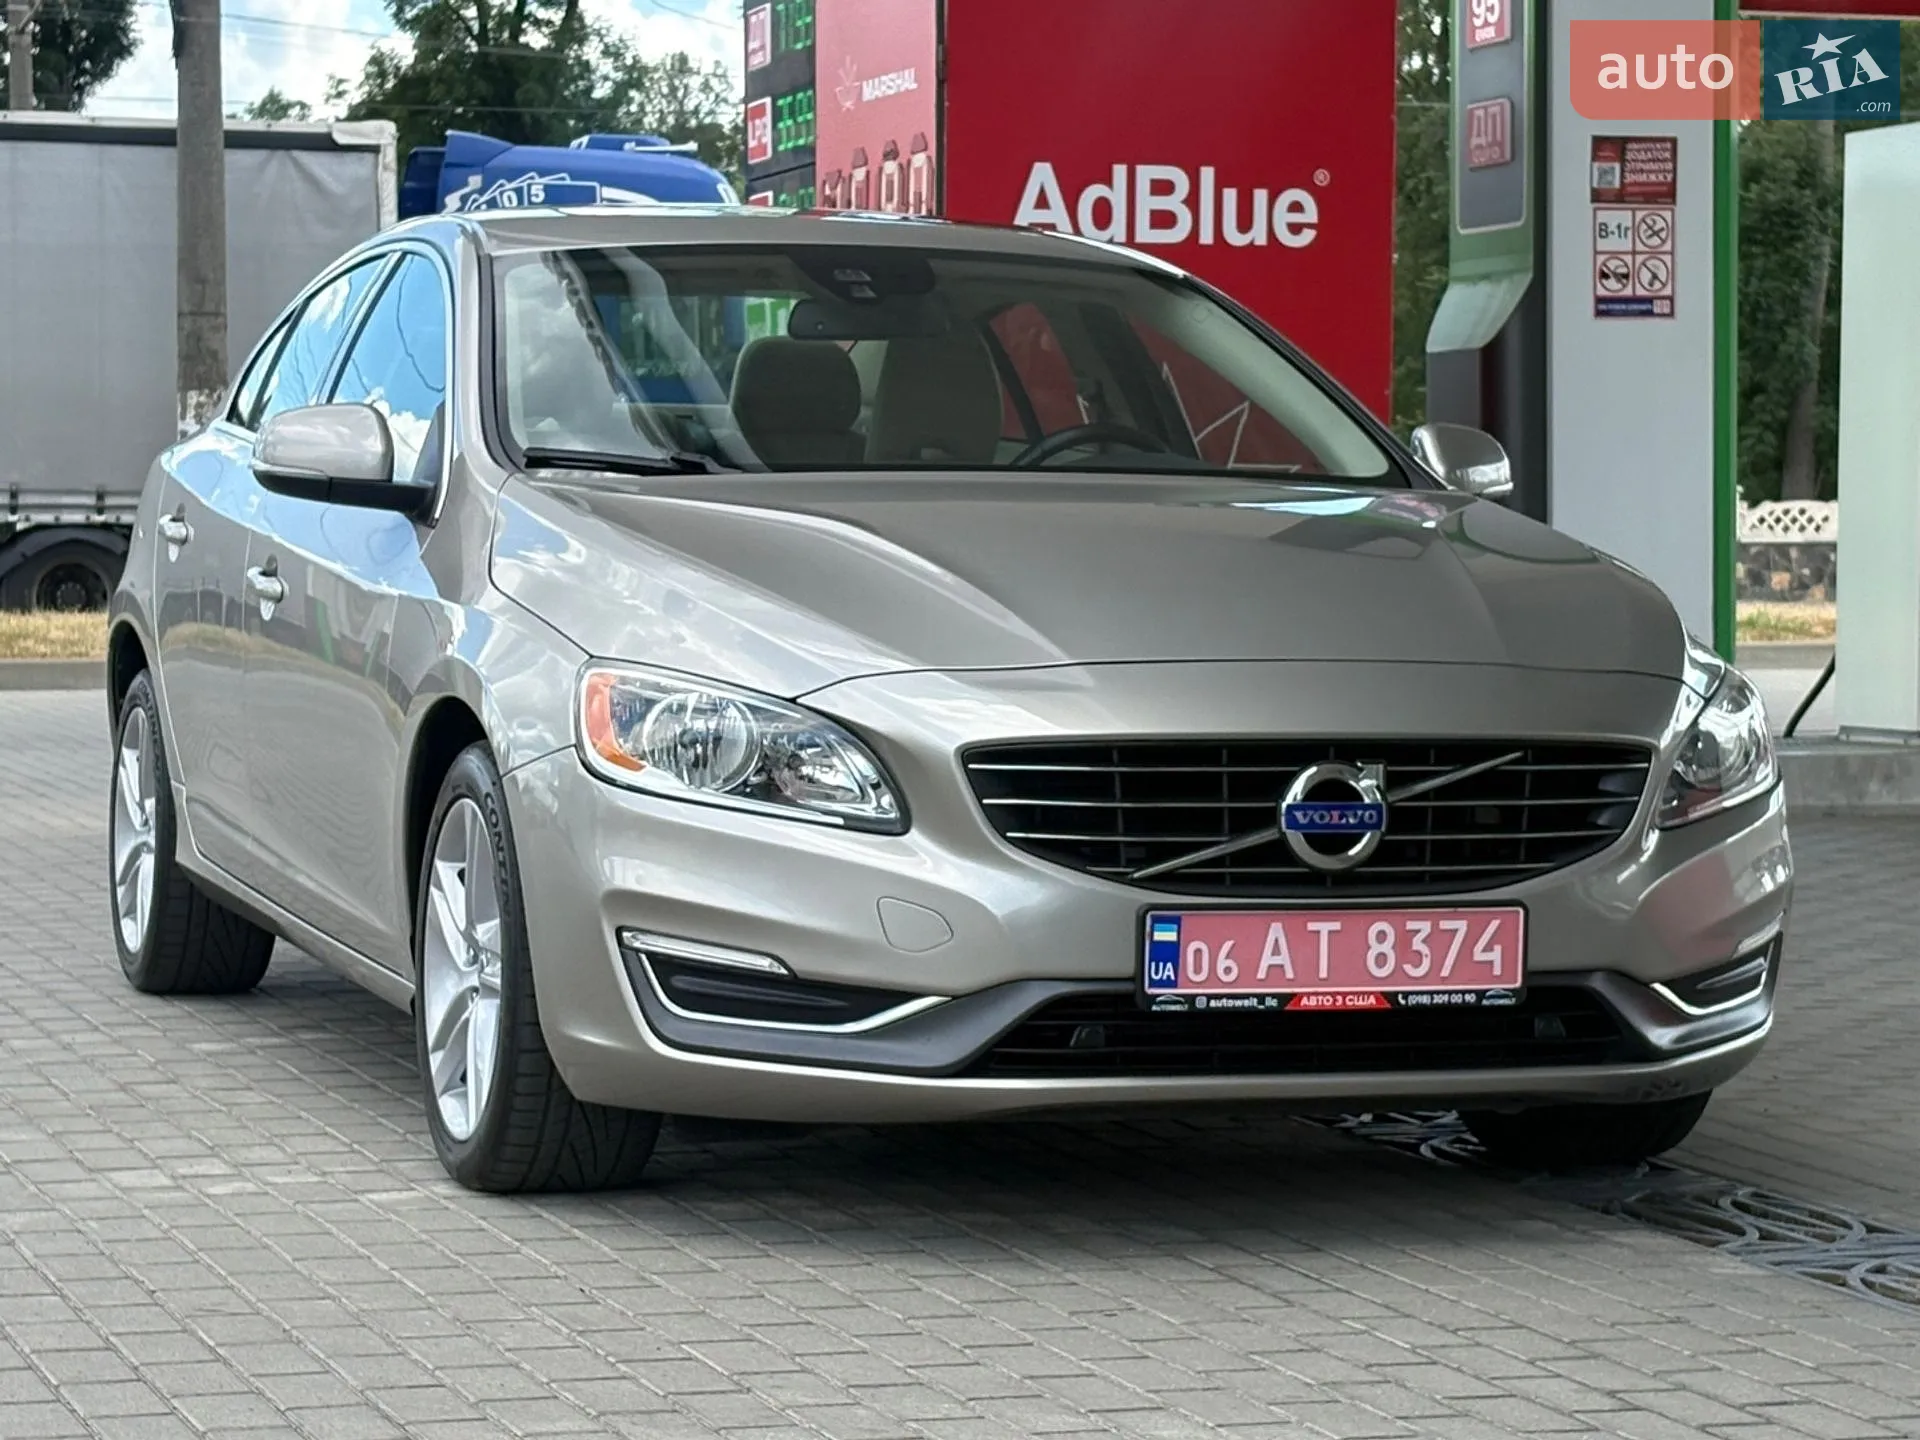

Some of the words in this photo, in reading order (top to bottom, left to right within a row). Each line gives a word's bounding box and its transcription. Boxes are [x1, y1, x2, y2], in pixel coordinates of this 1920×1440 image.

[1472, 0, 1499, 27] 95
[861, 67, 918, 102] MARSHAL
[1470, 106, 1502, 148] ДП
[1012, 161, 1319, 248] AdBlue
[1292, 809, 1377, 824] VOLVO
[1185, 941, 1239, 983] 06
[1256, 920, 1341, 981] AT
[1366, 919, 1503, 979] 8374
[1151, 962, 1175, 981] UA
[1300, 995, 1332, 1006] АВТО
[1345, 994, 1377, 1006] США
